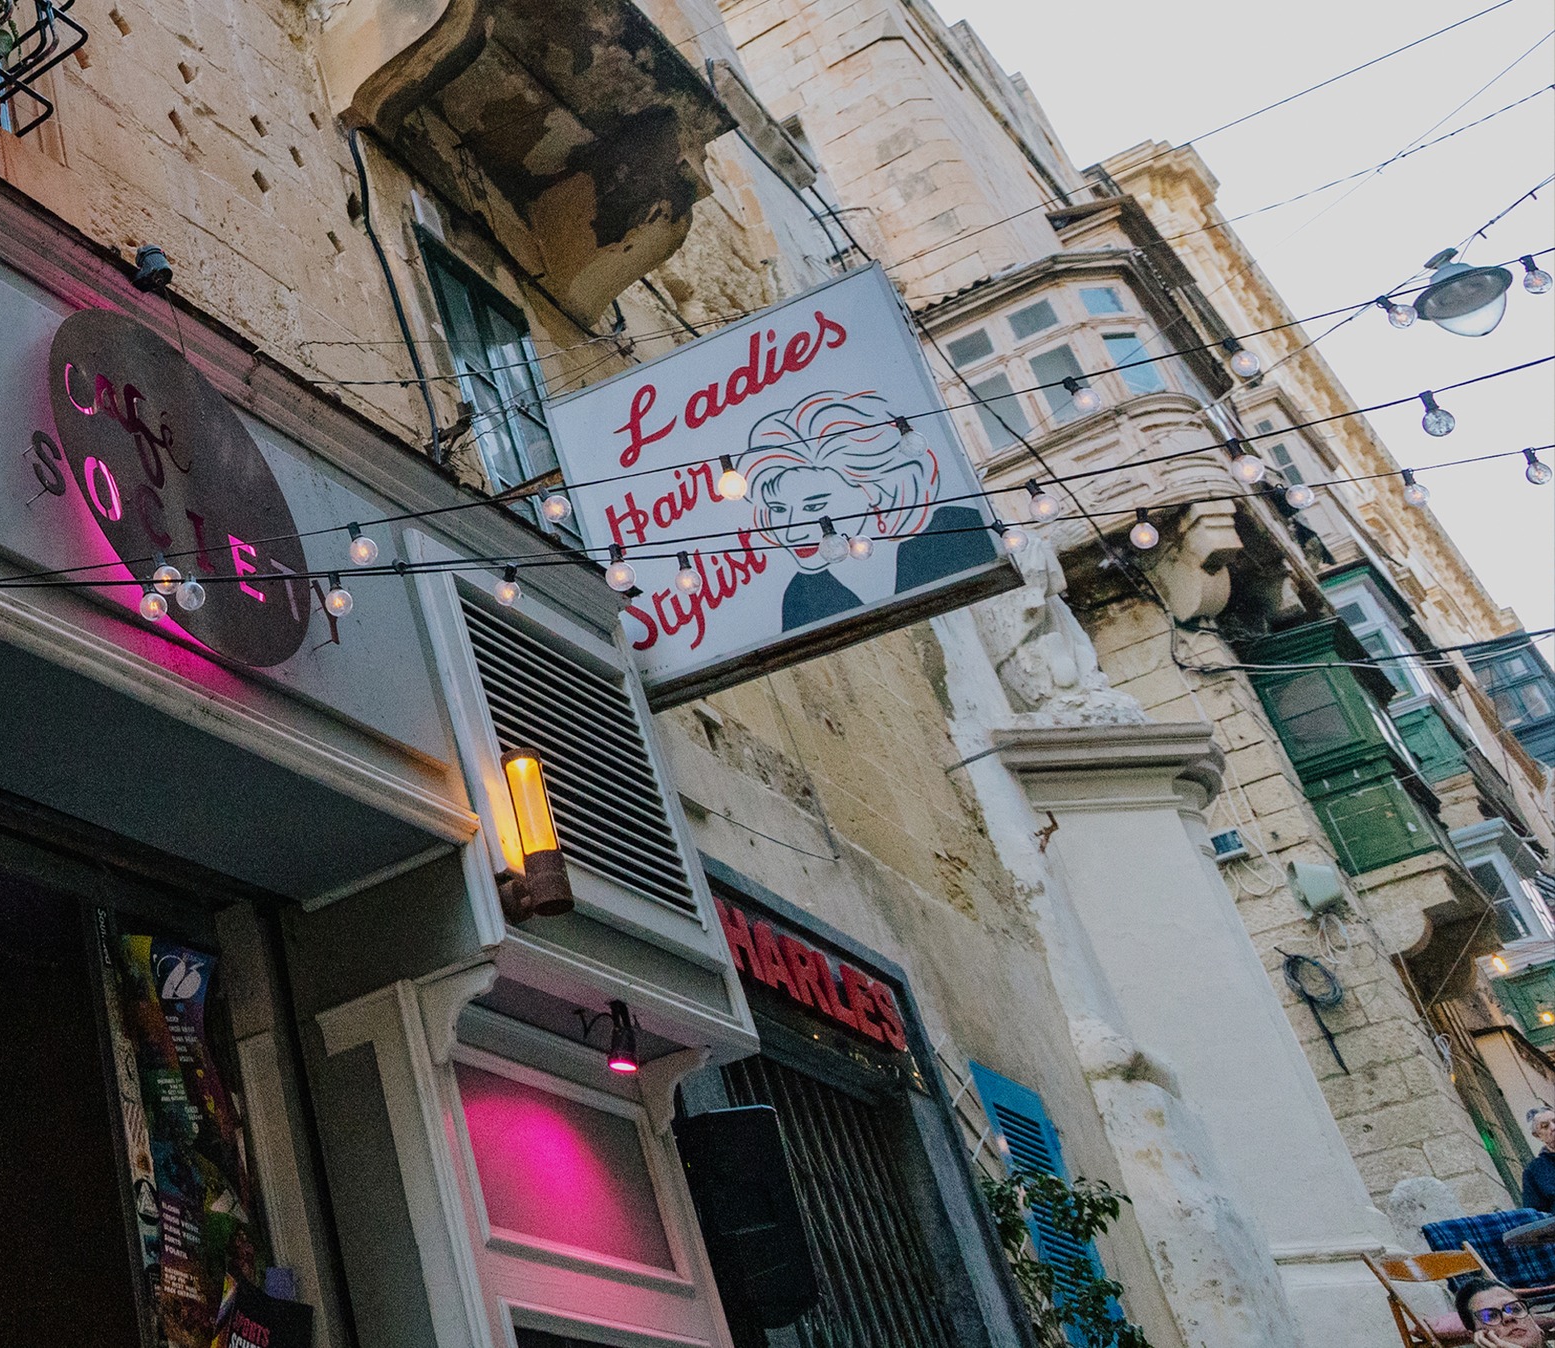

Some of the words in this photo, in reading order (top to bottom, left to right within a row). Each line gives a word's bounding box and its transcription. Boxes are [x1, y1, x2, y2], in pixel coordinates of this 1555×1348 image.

[612, 310, 847, 468] Ladies
[31, 430, 340, 645] SOCIETY
[605, 462, 725, 556] Hair
[625, 527, 767, 650] Stylist
